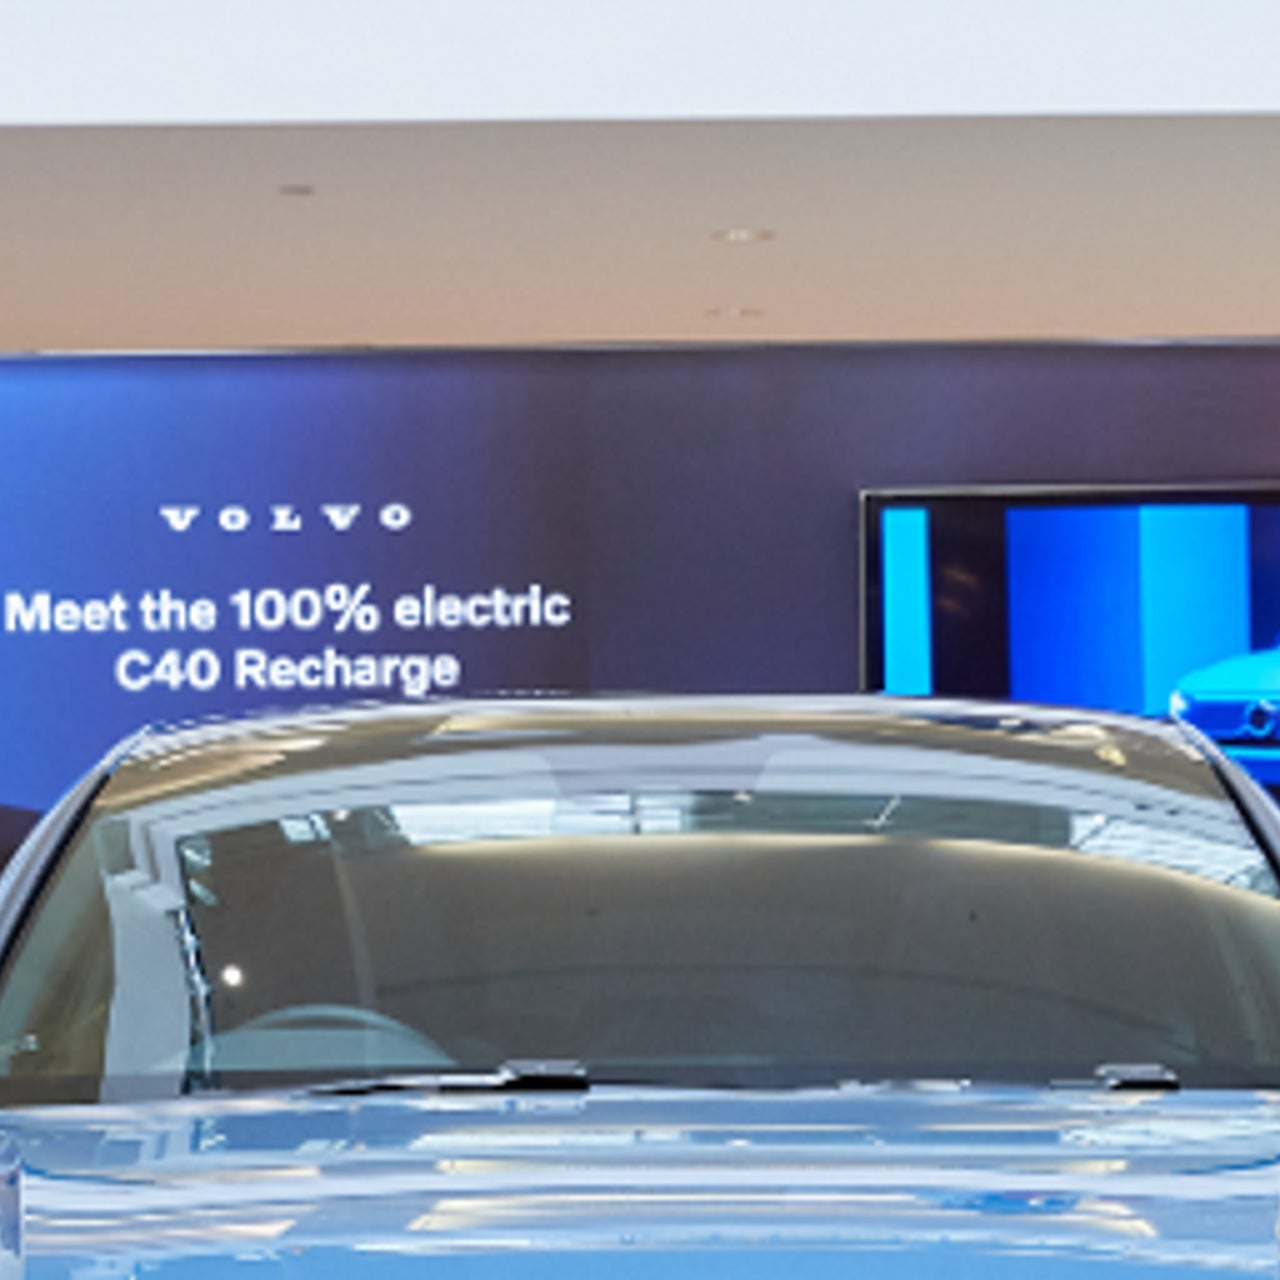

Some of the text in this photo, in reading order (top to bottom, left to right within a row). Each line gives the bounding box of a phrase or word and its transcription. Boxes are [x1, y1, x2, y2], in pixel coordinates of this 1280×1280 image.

[160, 502, 412, 532] VOLVO
[4, 582, 571, 632] Meet the 100% electric
[114, 647, 461, 699] C40 Recharge
